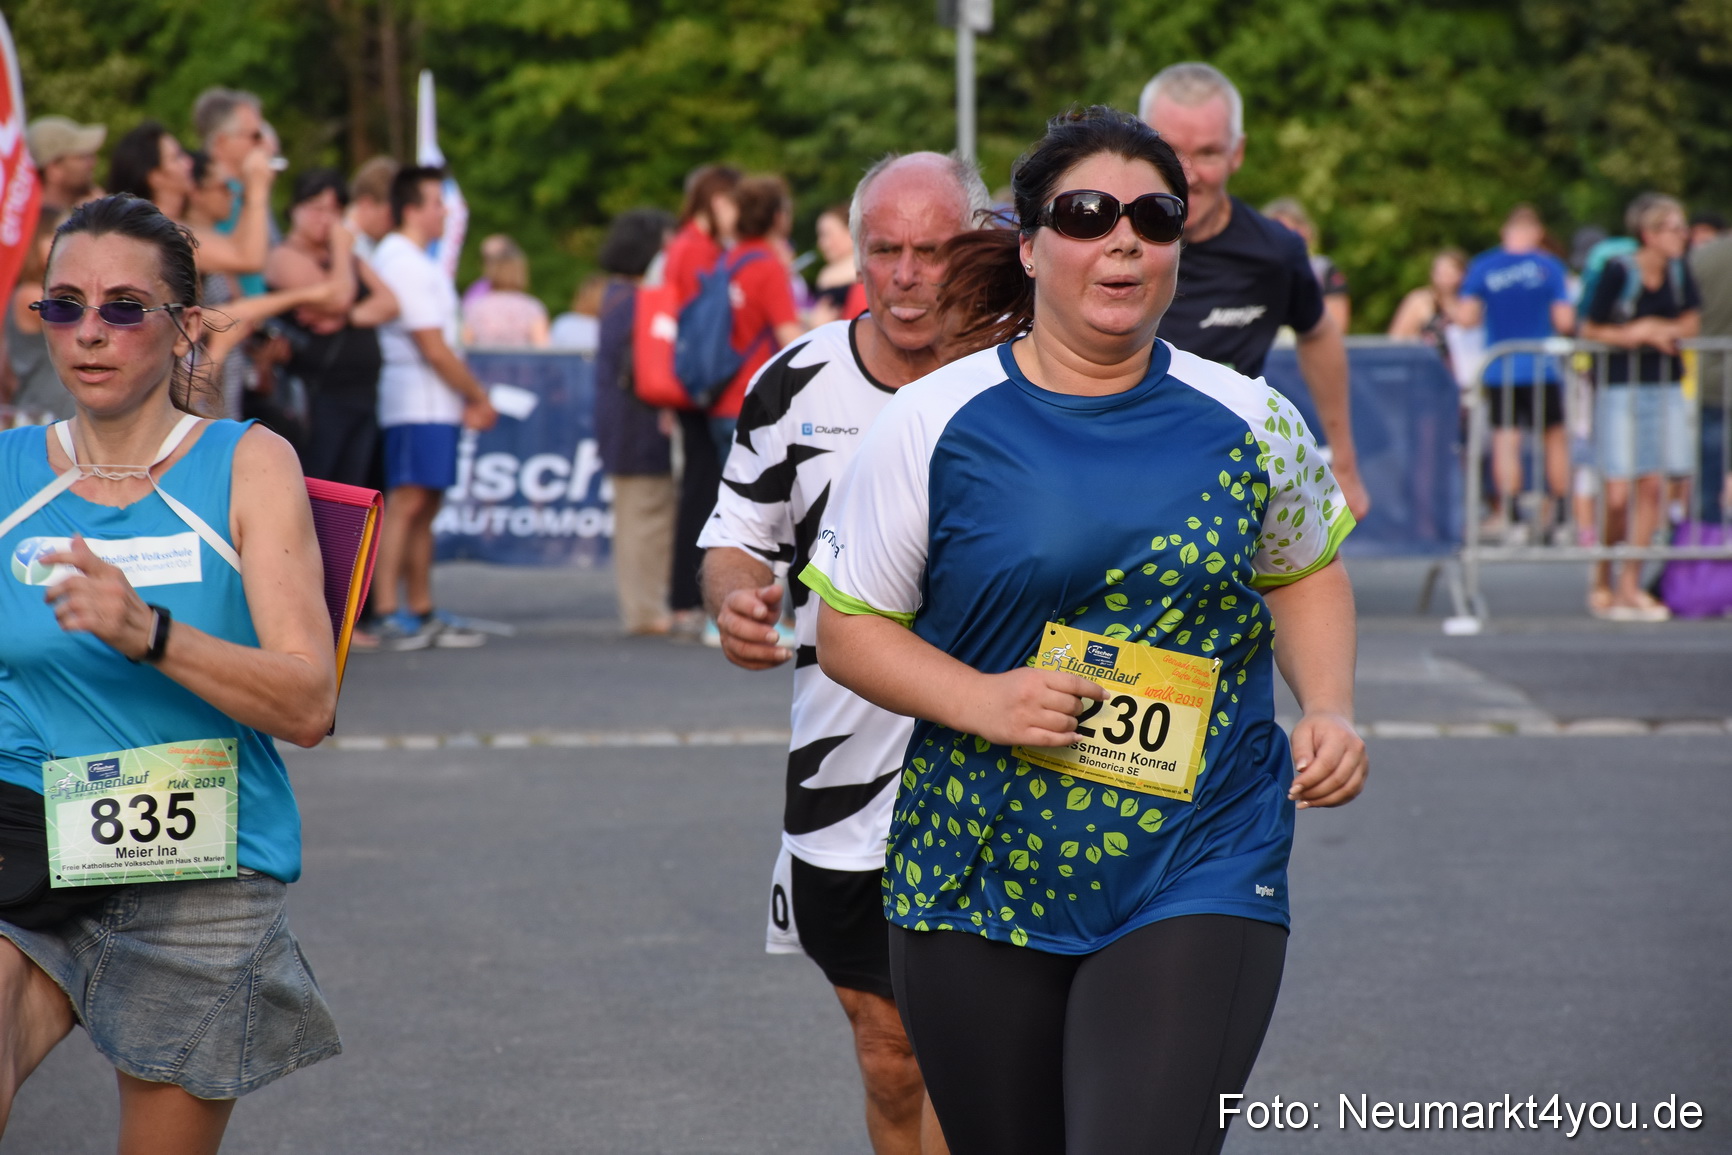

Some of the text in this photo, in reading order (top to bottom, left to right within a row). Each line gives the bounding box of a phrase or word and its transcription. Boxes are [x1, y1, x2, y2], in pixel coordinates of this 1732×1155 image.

[1066, 657, 1142, 686] firmenlauf
[1144, 685, 1204, 708] walk 2019
[1066, 740, 1126, 762] ssmann
[1130, 751, 1177, 772] Konrad
[1079, 754, 1125, 773] Bionorica
[1126, 766, 1140, 777] SE
[74, 770, 150, 793] firmenlauf
[194, 776, 226, 789] 2019
[91, 792, 196, 845] 835
[62, 864, 80, 872] Freie
[82, 861, 123, 870] Katholische
[124, 859, 165, 868] Volksschule
[203, 855, 225, 863] Marien
[115, 845, 178, 859] Meier Ina
